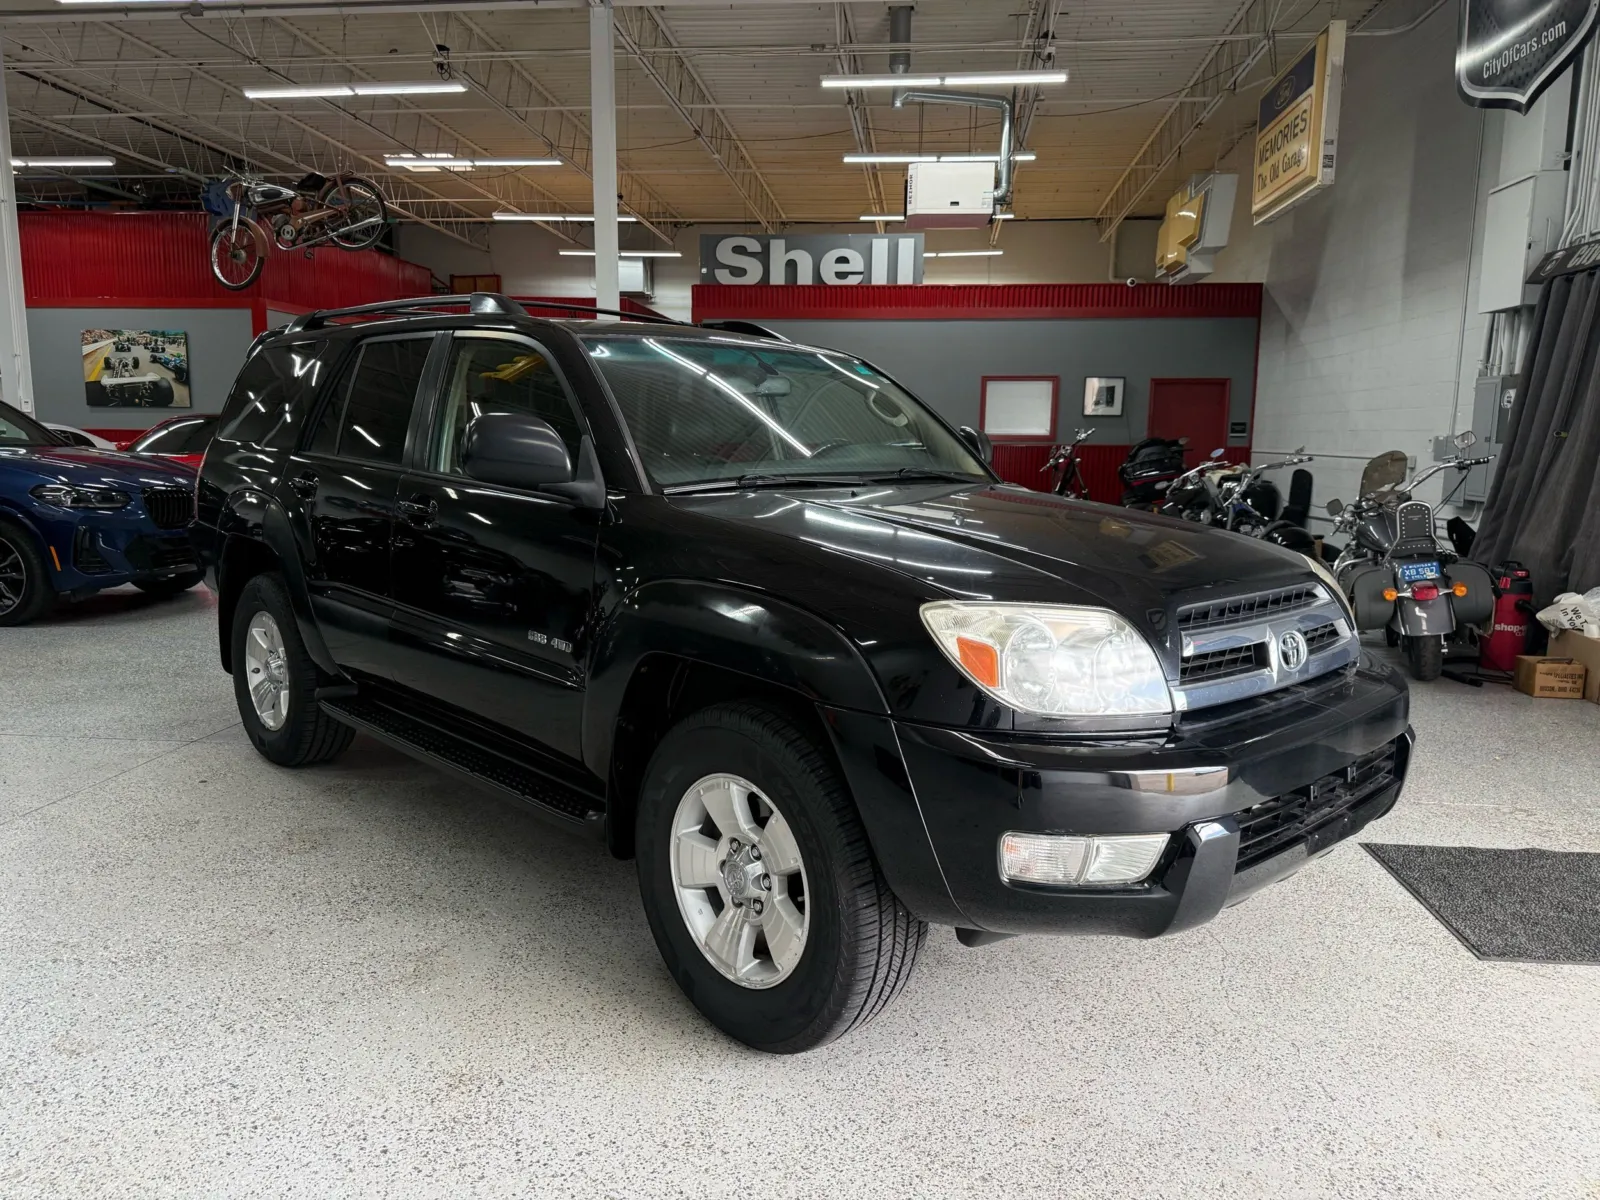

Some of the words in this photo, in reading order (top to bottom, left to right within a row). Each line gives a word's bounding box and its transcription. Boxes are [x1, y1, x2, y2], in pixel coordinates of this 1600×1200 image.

[1483, 21, 1566, 79] CityOfCars.com
[1258, 109, 1308, 167] MEMORIES
[1257, 173, 1267, 193] The
[1269, 160, 1280, 184] Old
[714, 236, 915, 286] Shell
[1560, 607, 1569, 617] In
[1570, 606, 1582, 621] We
